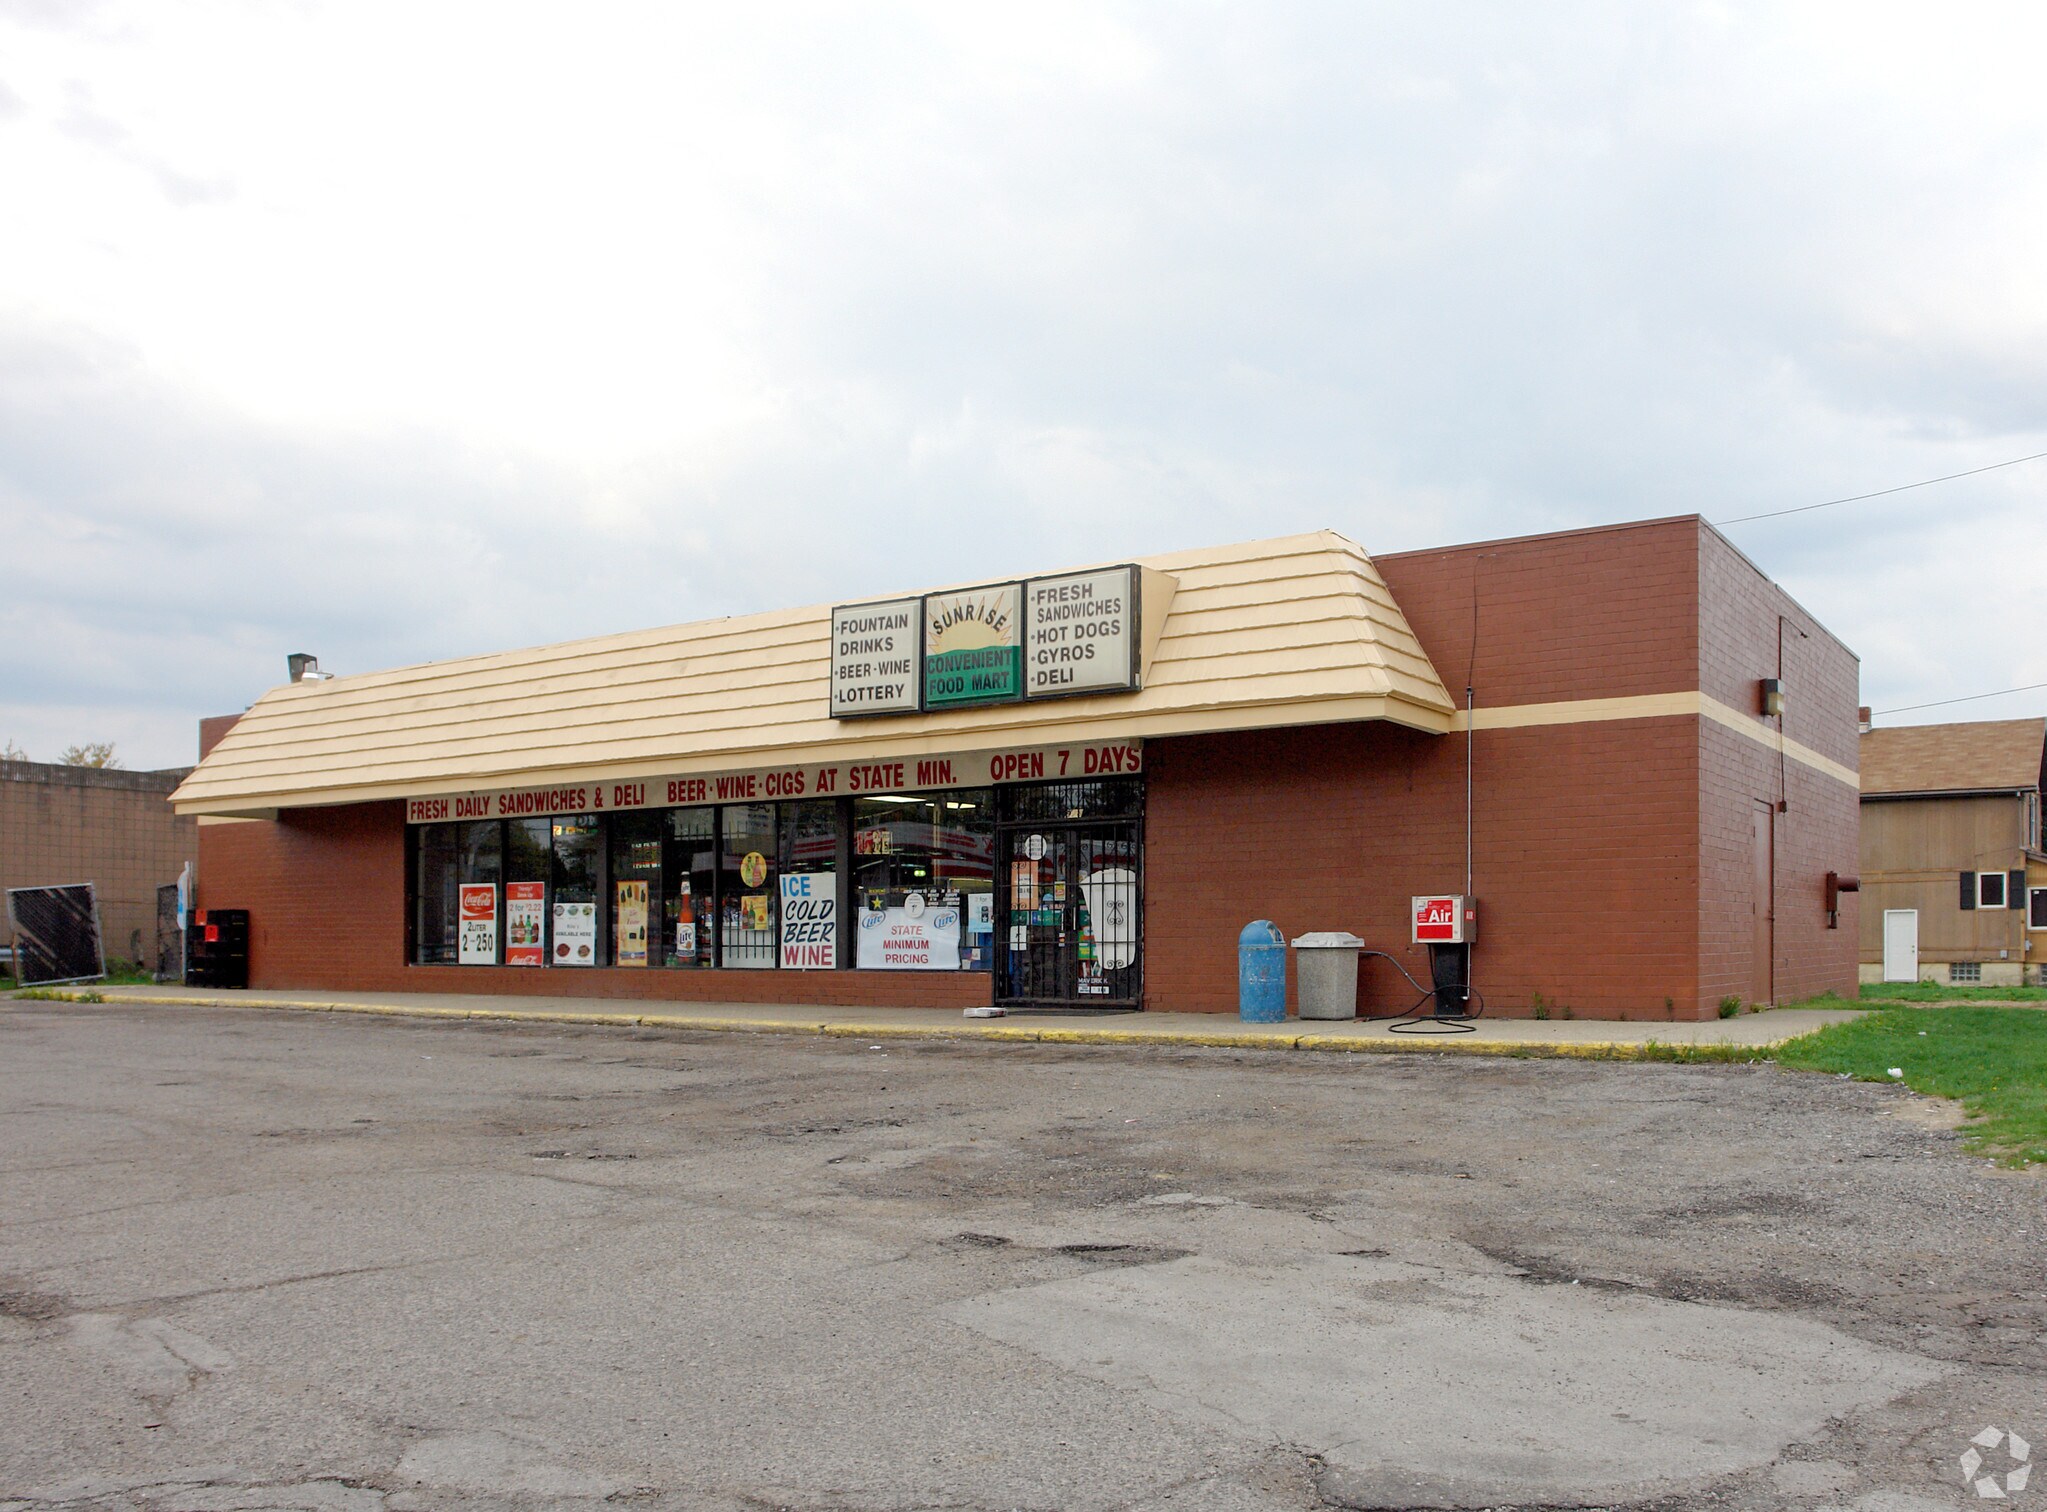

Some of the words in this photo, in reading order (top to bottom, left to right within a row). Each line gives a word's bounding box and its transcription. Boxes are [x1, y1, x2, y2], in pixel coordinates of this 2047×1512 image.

[1037, 583, 1092, 605] FRESH
[933, 604, 1007, 635] SUNRISE
[1037, 598, 1121, 623] SANDWICHES
[840, 613, 908, 635] FOUNTAIN
[1037, 626, 1068, 644] HOT
[1075, 619, 1120, 639] DOGS
[840, 637, 893, 656] DRINKS
[1037, 643, 1095, 665] GYROS
[840, 663, 871, 680] BEER
[878, 659, 910, 675] WINE
[928, 648, 1012, 674] CONVENIENT
[930, 676, 964, 695] FOOD
[972, 671, 1009, 690] MART
[1037, 667, 1073, 686] DELI
[839, 684, 905, 703] LOTTERY
[410, 799, 448, 820] FRESH
[456, 796, 490, 817] DAILY
[499, 788, 585, 814] SANDWICHES
[595, 787, 603, 808] &
[614, 783, 645, 807] DELI
[667, 779, 706, 803] BEER
[716, 775, 756, 799] WINE
[765, 770, 805, 796] CIGS
[816, 768, 838, 792] AT
[850, 763, 904, 791] STATE
[917, 759, 957, 786] MIN.
[990, 752, 1044, 781] OPEN
[1057, 750, 1070, 776] 7
[1084, 746, 1140, 774] DAYS
[782, 876, 811, 897] ICE
[785, 900, 834, 920] COLD
[1428, 909, 1451, 922] Air
[783, 921, 835, 943] BEER
[891, 925, 923, 936] STATE
[784, 944, 832, 966] WINE
[883, 940, 930, 949] MINIMUM
[885, 954, 928, 964] PRICING
